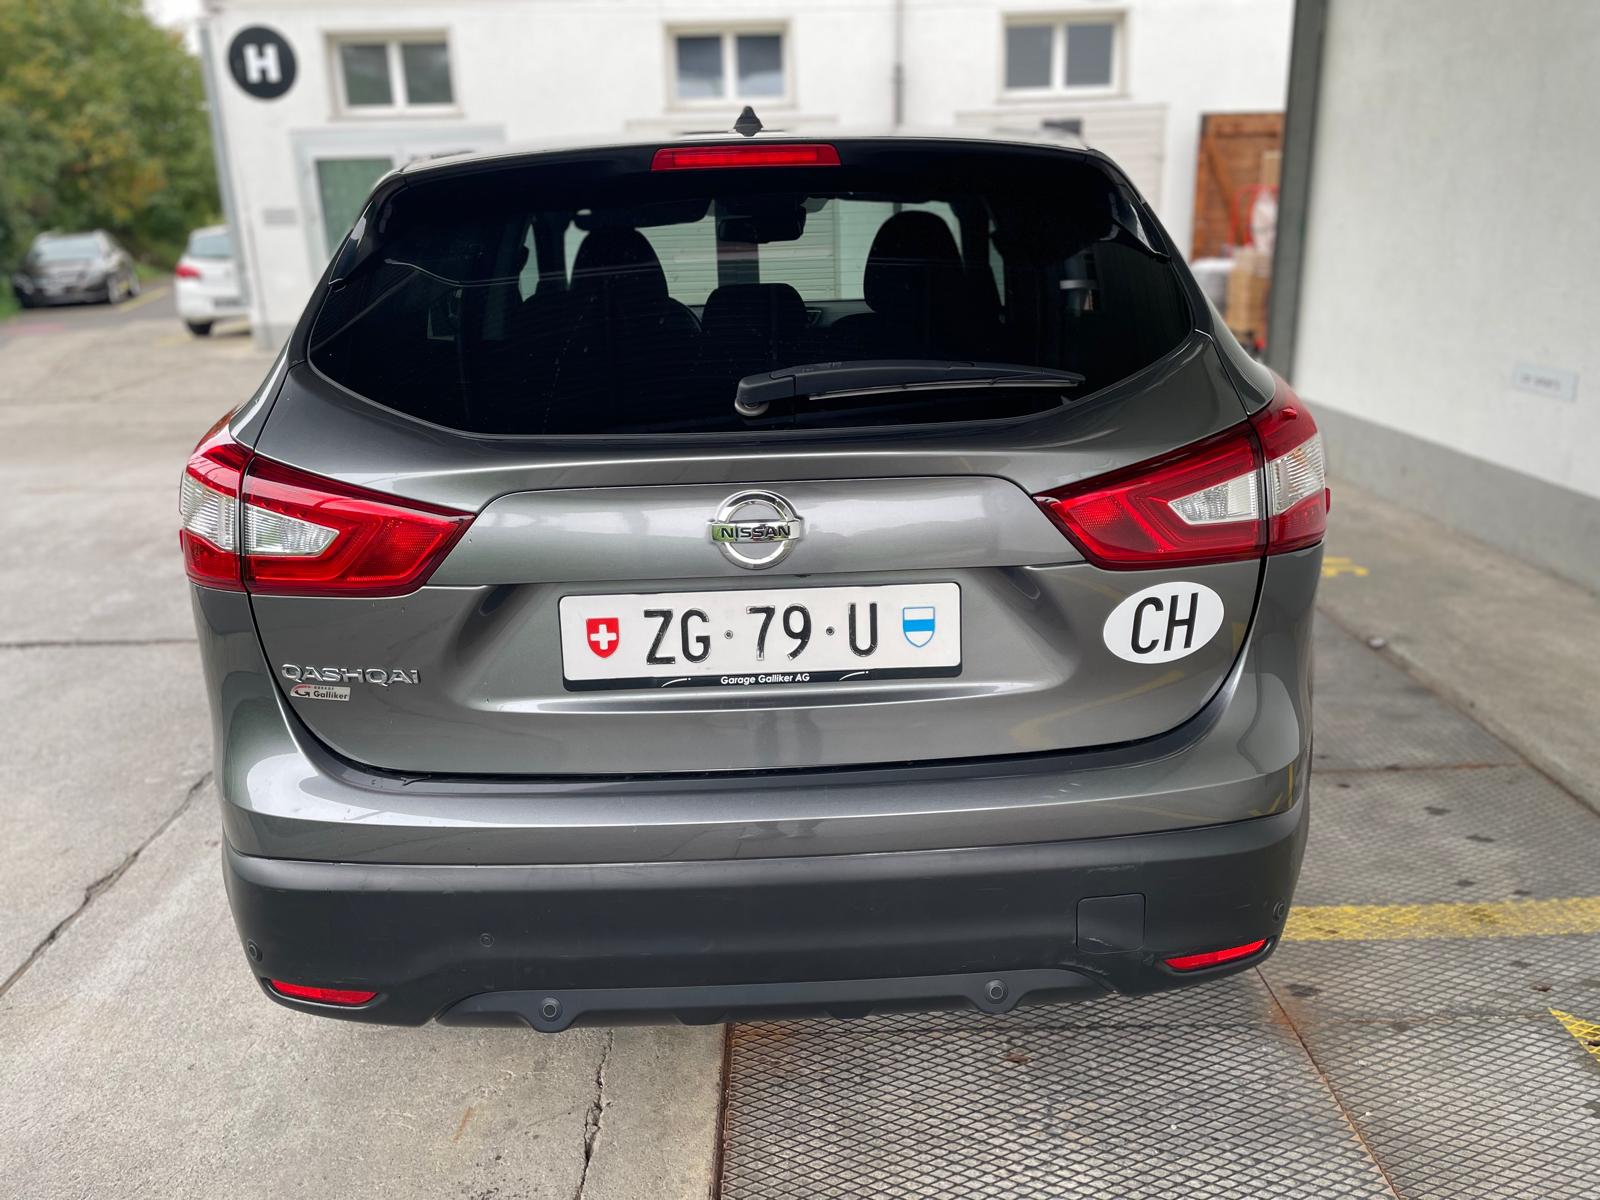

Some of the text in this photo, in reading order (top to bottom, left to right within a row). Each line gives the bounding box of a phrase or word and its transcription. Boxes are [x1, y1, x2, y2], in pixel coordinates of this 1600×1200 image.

[243, 43, 282, 84] H
[720, 524, 791, 539] NISSAN
[1131, 592, 1199, 655] CH
[281, 663, 420, 687] QASHQAI
[720, 672, 810, 686] Garage Galliker AG
[313, 690, 348, 700] Galliker
